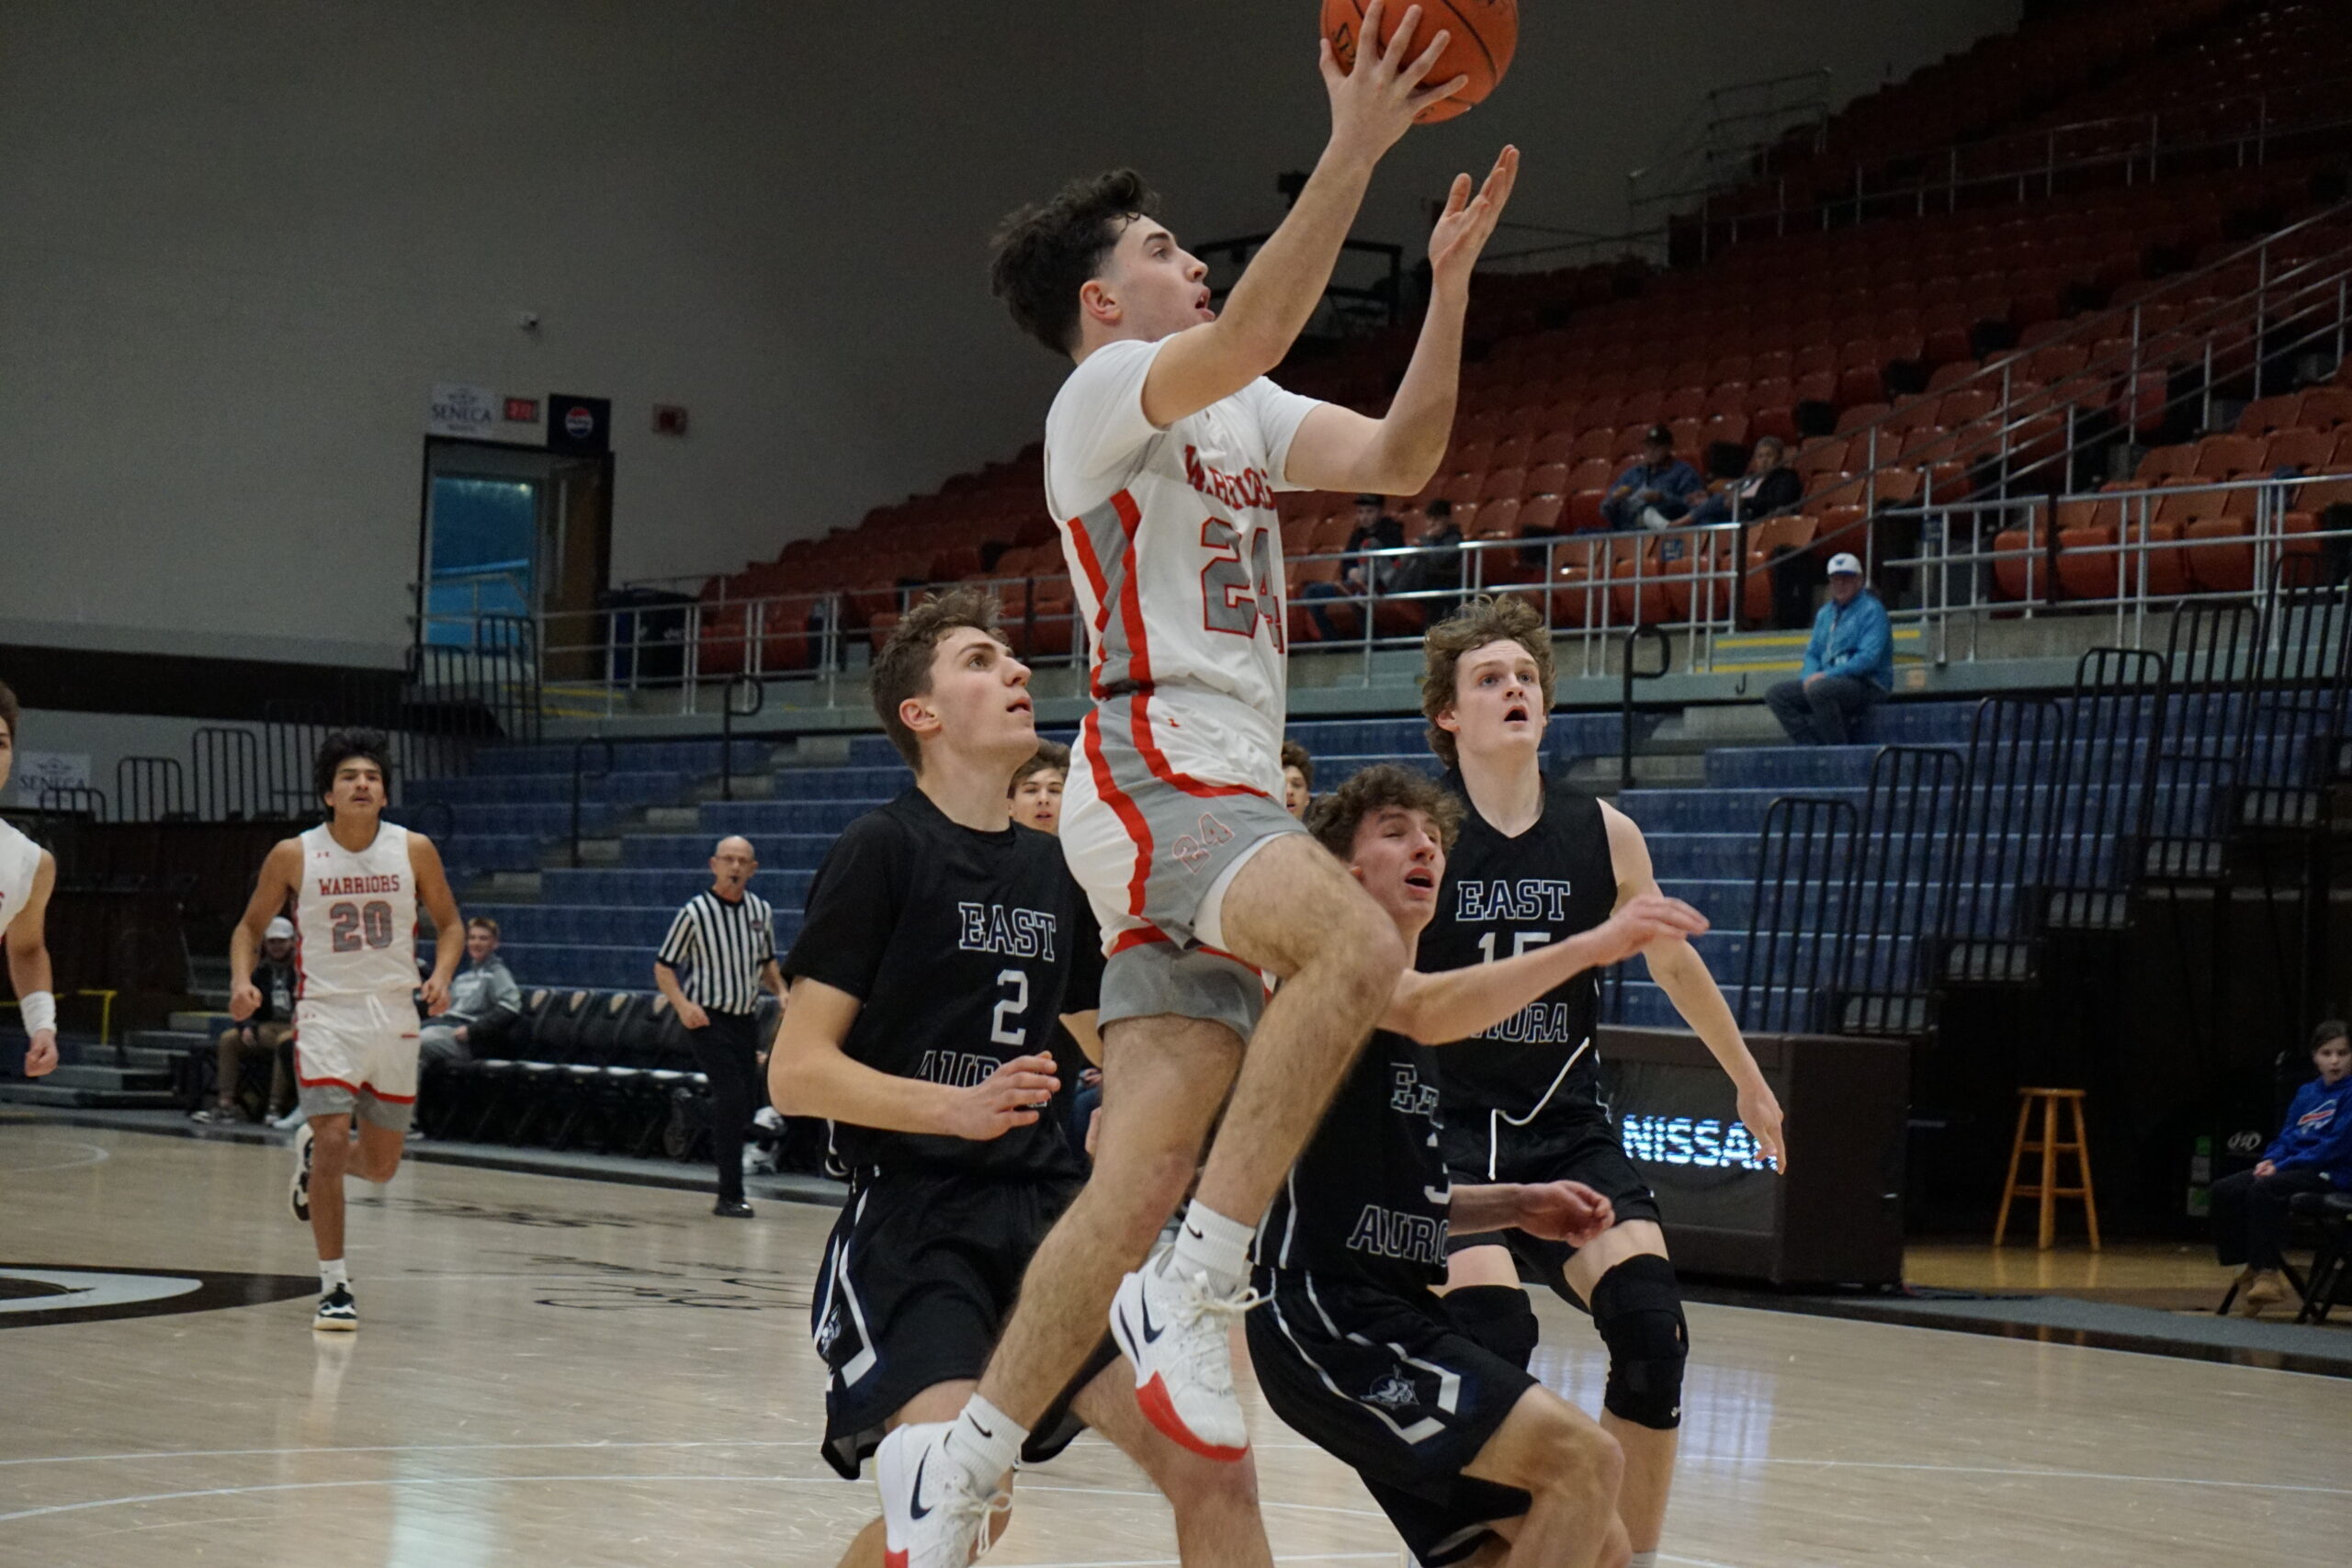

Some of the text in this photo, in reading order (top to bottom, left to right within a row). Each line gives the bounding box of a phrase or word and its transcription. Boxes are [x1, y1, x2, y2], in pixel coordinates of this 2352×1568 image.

[1200, 516, 1285, 654] 24
[1172, 812, 1235, 875] 24
[318, 874, 401, 897] WARRIORS
[1455, 878, 1571, 922] EAST
[329, 899, 393, 953] 20
[958, 901, 1057, 963] EAST
[990, 968, 1029, 1046] 2
